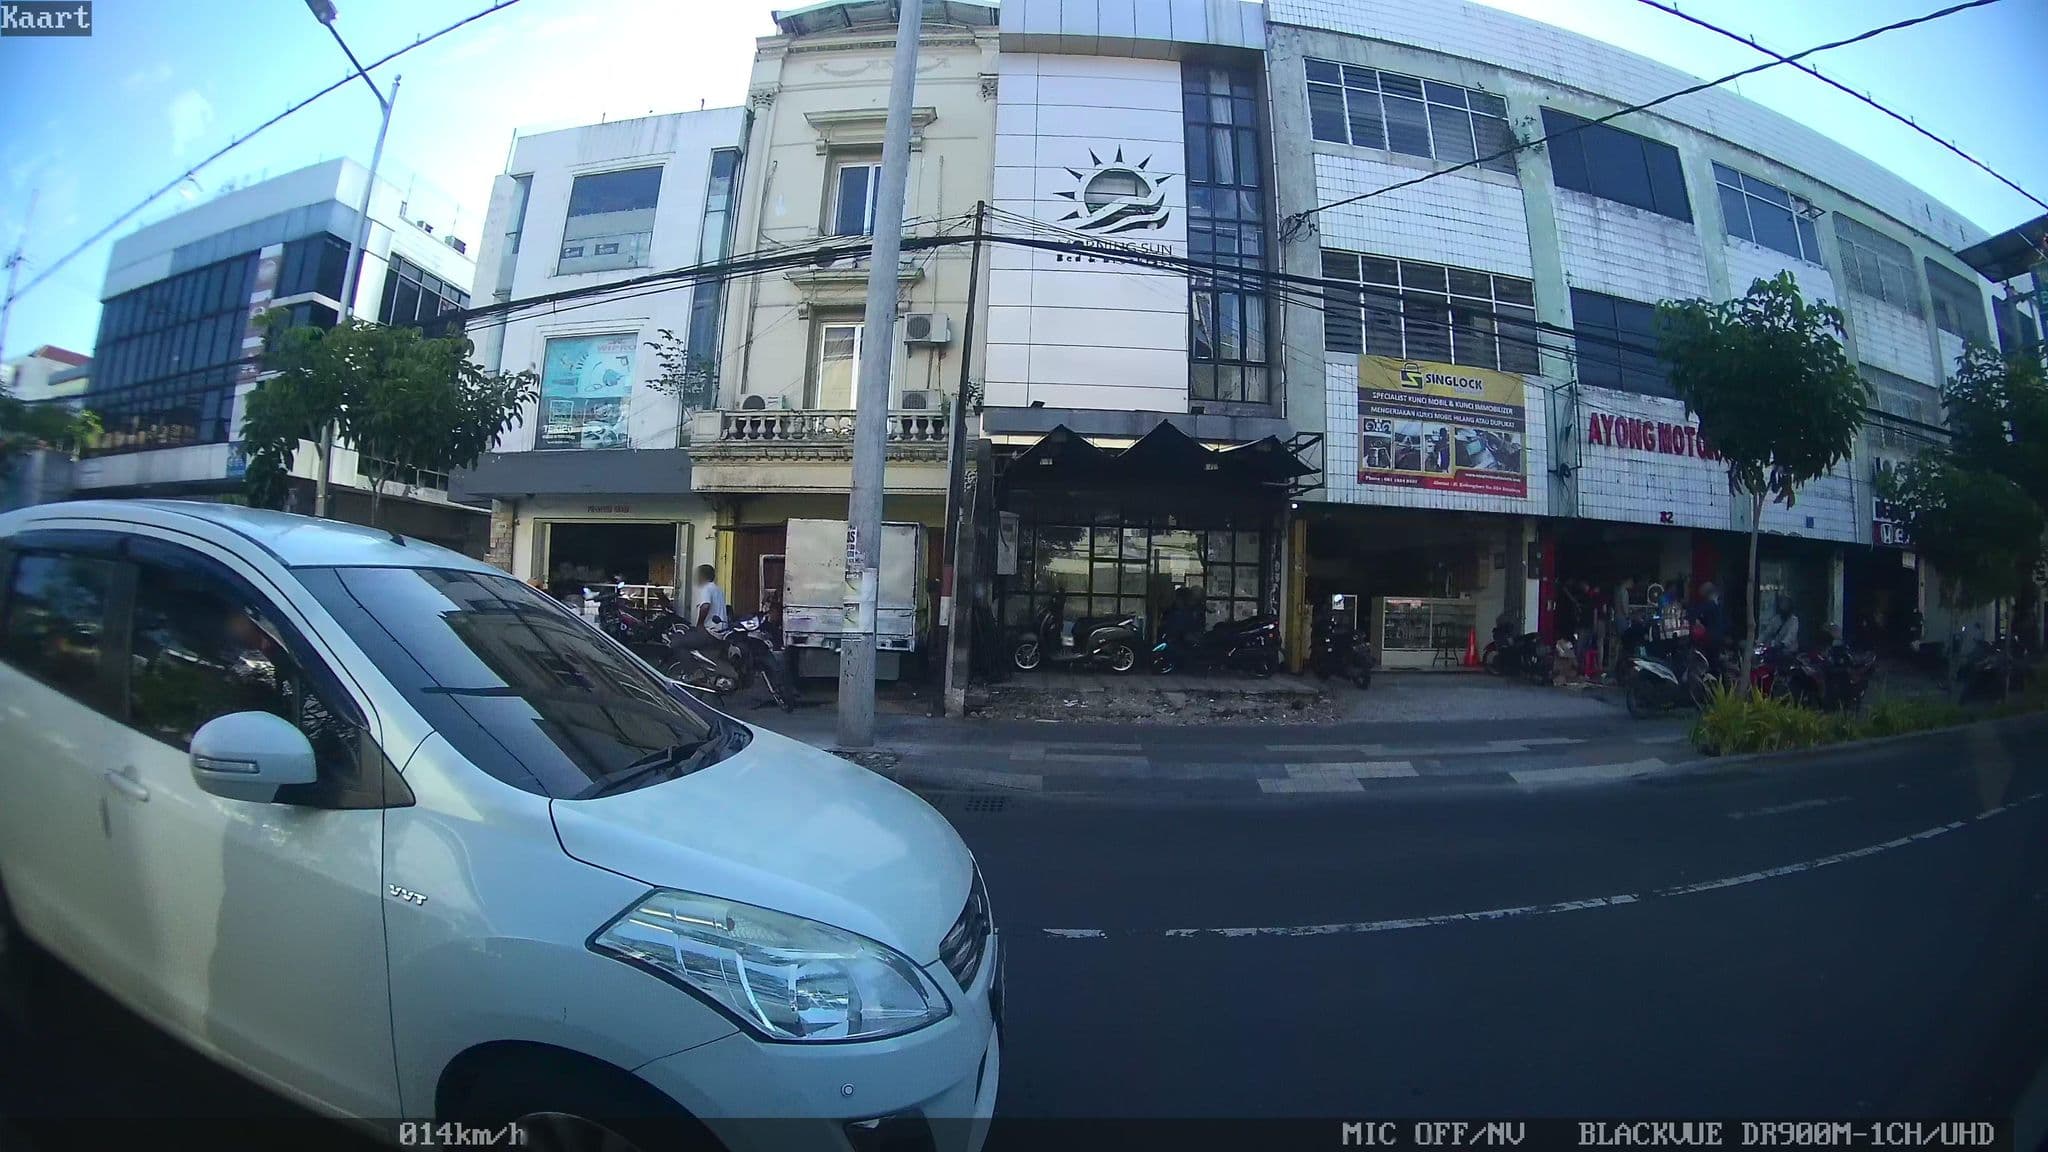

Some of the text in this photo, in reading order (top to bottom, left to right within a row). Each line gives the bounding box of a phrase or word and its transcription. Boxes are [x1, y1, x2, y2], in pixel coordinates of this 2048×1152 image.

[1141, 242, 1172, 256] SUN
[1425, 373, 1482, 390] SINGLOCK
[1372, 391, 1407, 403] SPECIALIST
[1408, 396, 1427, 404] KUNCI
[1428, 398, 1448, 407] MOBIL
[1455, 402, 1474, 410] KUNCI
[1589, 412, 1721, 460] AYONG MOTO
[389, 884, 428, 906] VVT
